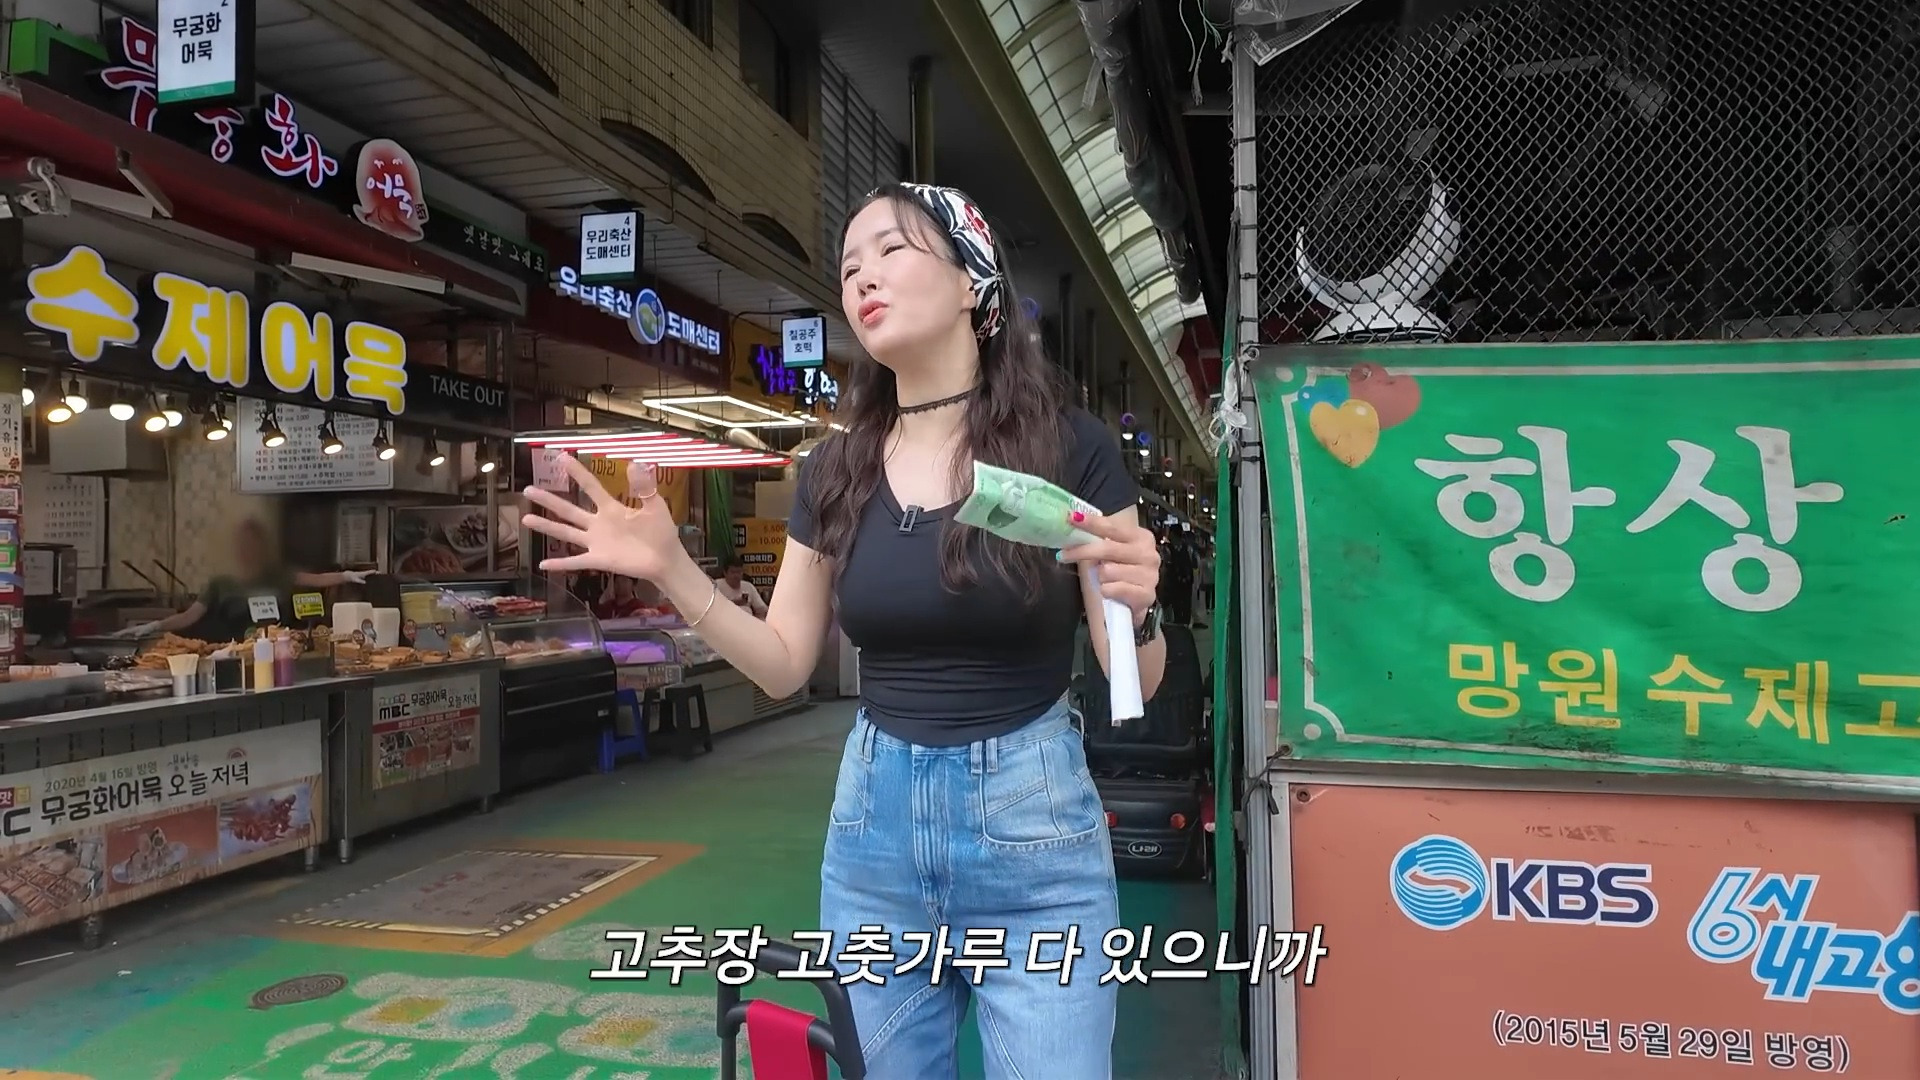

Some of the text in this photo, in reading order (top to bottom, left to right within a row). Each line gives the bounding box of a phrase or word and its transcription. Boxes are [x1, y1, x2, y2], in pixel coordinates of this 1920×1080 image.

[172, 12, 221, 38] 무궁화
[181, 40, 213, 64] 어묵
[624, 216, 631, 226] 4
[586, 228, 632, 244] 우리축산
[586, 244, 631, 260] 도매센터
[559, 265, 720, 355] 우리축산 도매센터
[813, 319, 819, 327] 6
[26, 245, 408, 415] 수제어묵
[789, 328, 816, 341] 칠공주
[794, 342, 813, 353] 호떡
[430, 375, 504, 407] TAKE OUT
[2, 403, 12, 458] 정기휴일
[1413, 425, 1845, 613] 항상
[411, 688, 447, 707] 무궁화어묵
[1448, 641, 1622, 729] 망원
[379, 703, 410, 720] MBC
[45, 760, 158, 793] 2020년 4월 16일 방영
[40, 761, 249, 826] 무궁화어묵 오늘 저녁
[1492, 859, 1657, 926] KBS
[1492, 1009, 1850, 1072] (2015년 5월 29일 방영)
